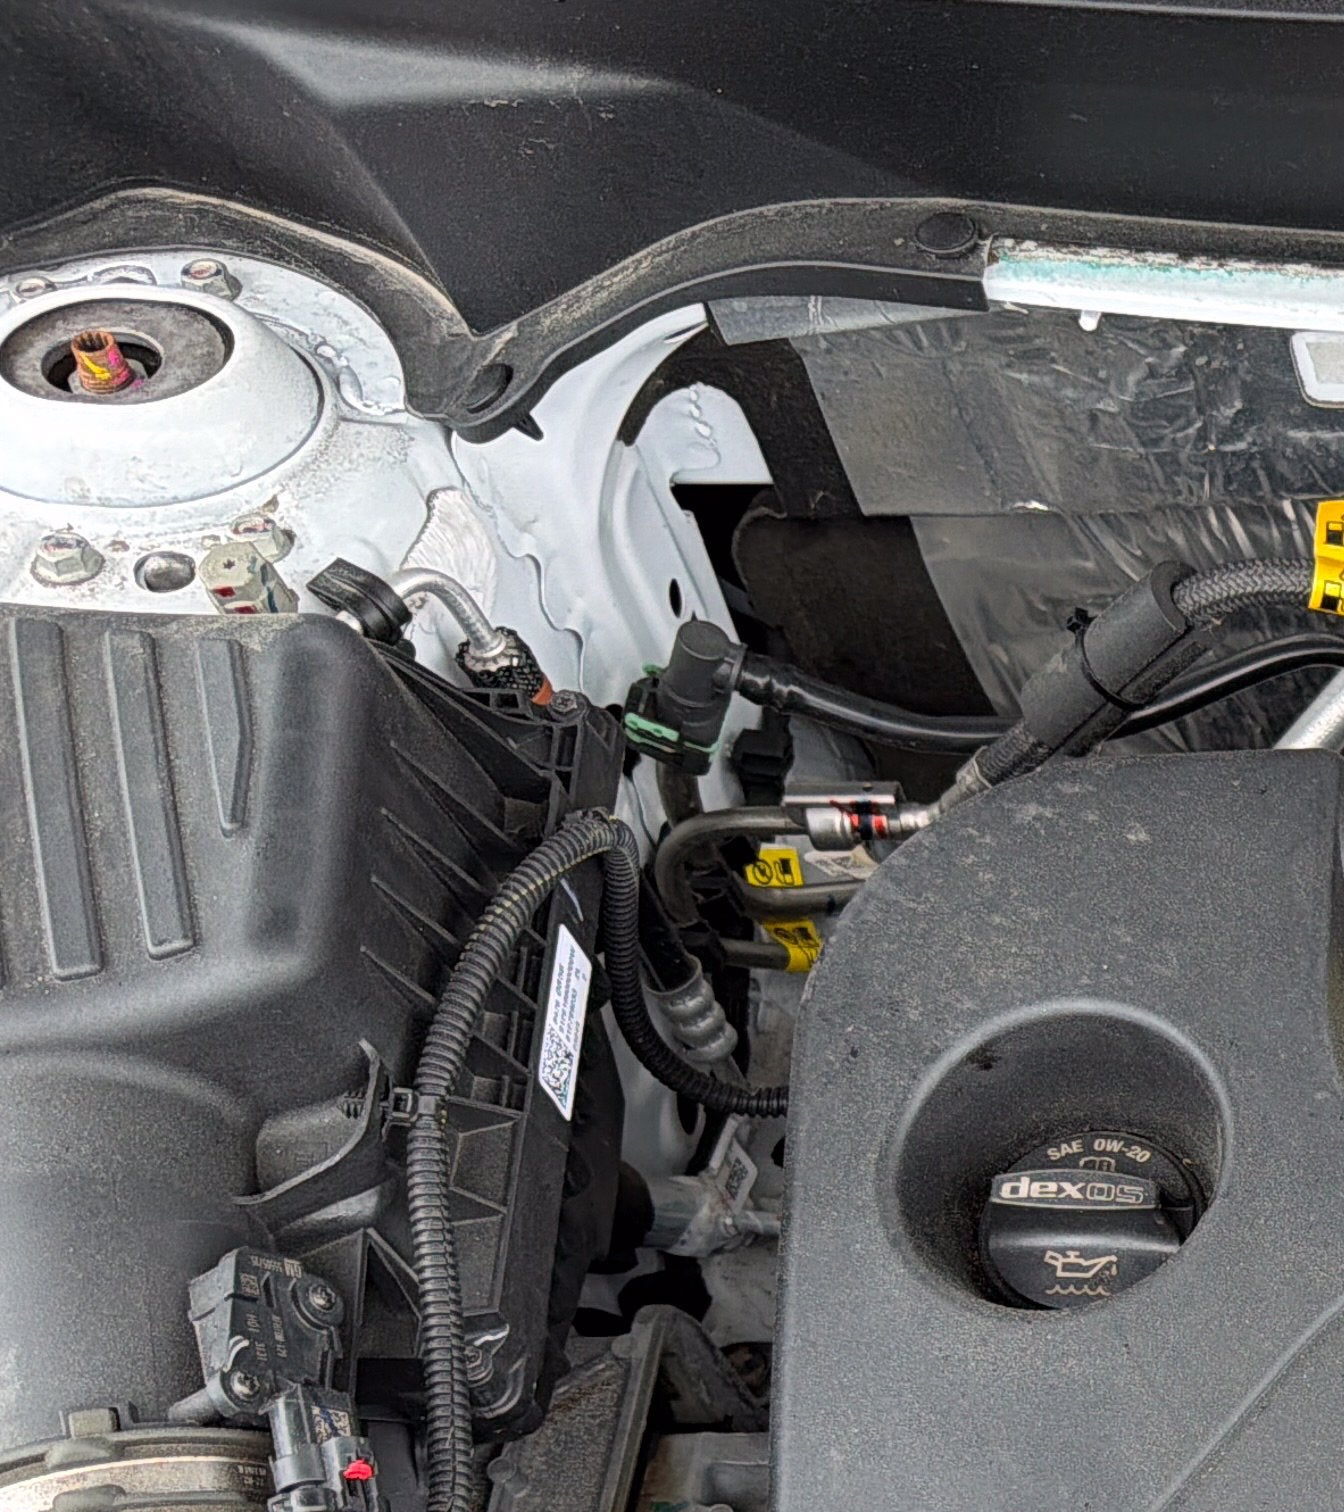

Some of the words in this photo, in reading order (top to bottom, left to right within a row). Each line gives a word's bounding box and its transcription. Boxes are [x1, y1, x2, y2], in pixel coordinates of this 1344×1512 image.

[1047, 1139, 1084, 1161] SAE
[1093, 1138, 1152, 1163] 0W-20
[999, 1176, 1144, 1204] dexos
